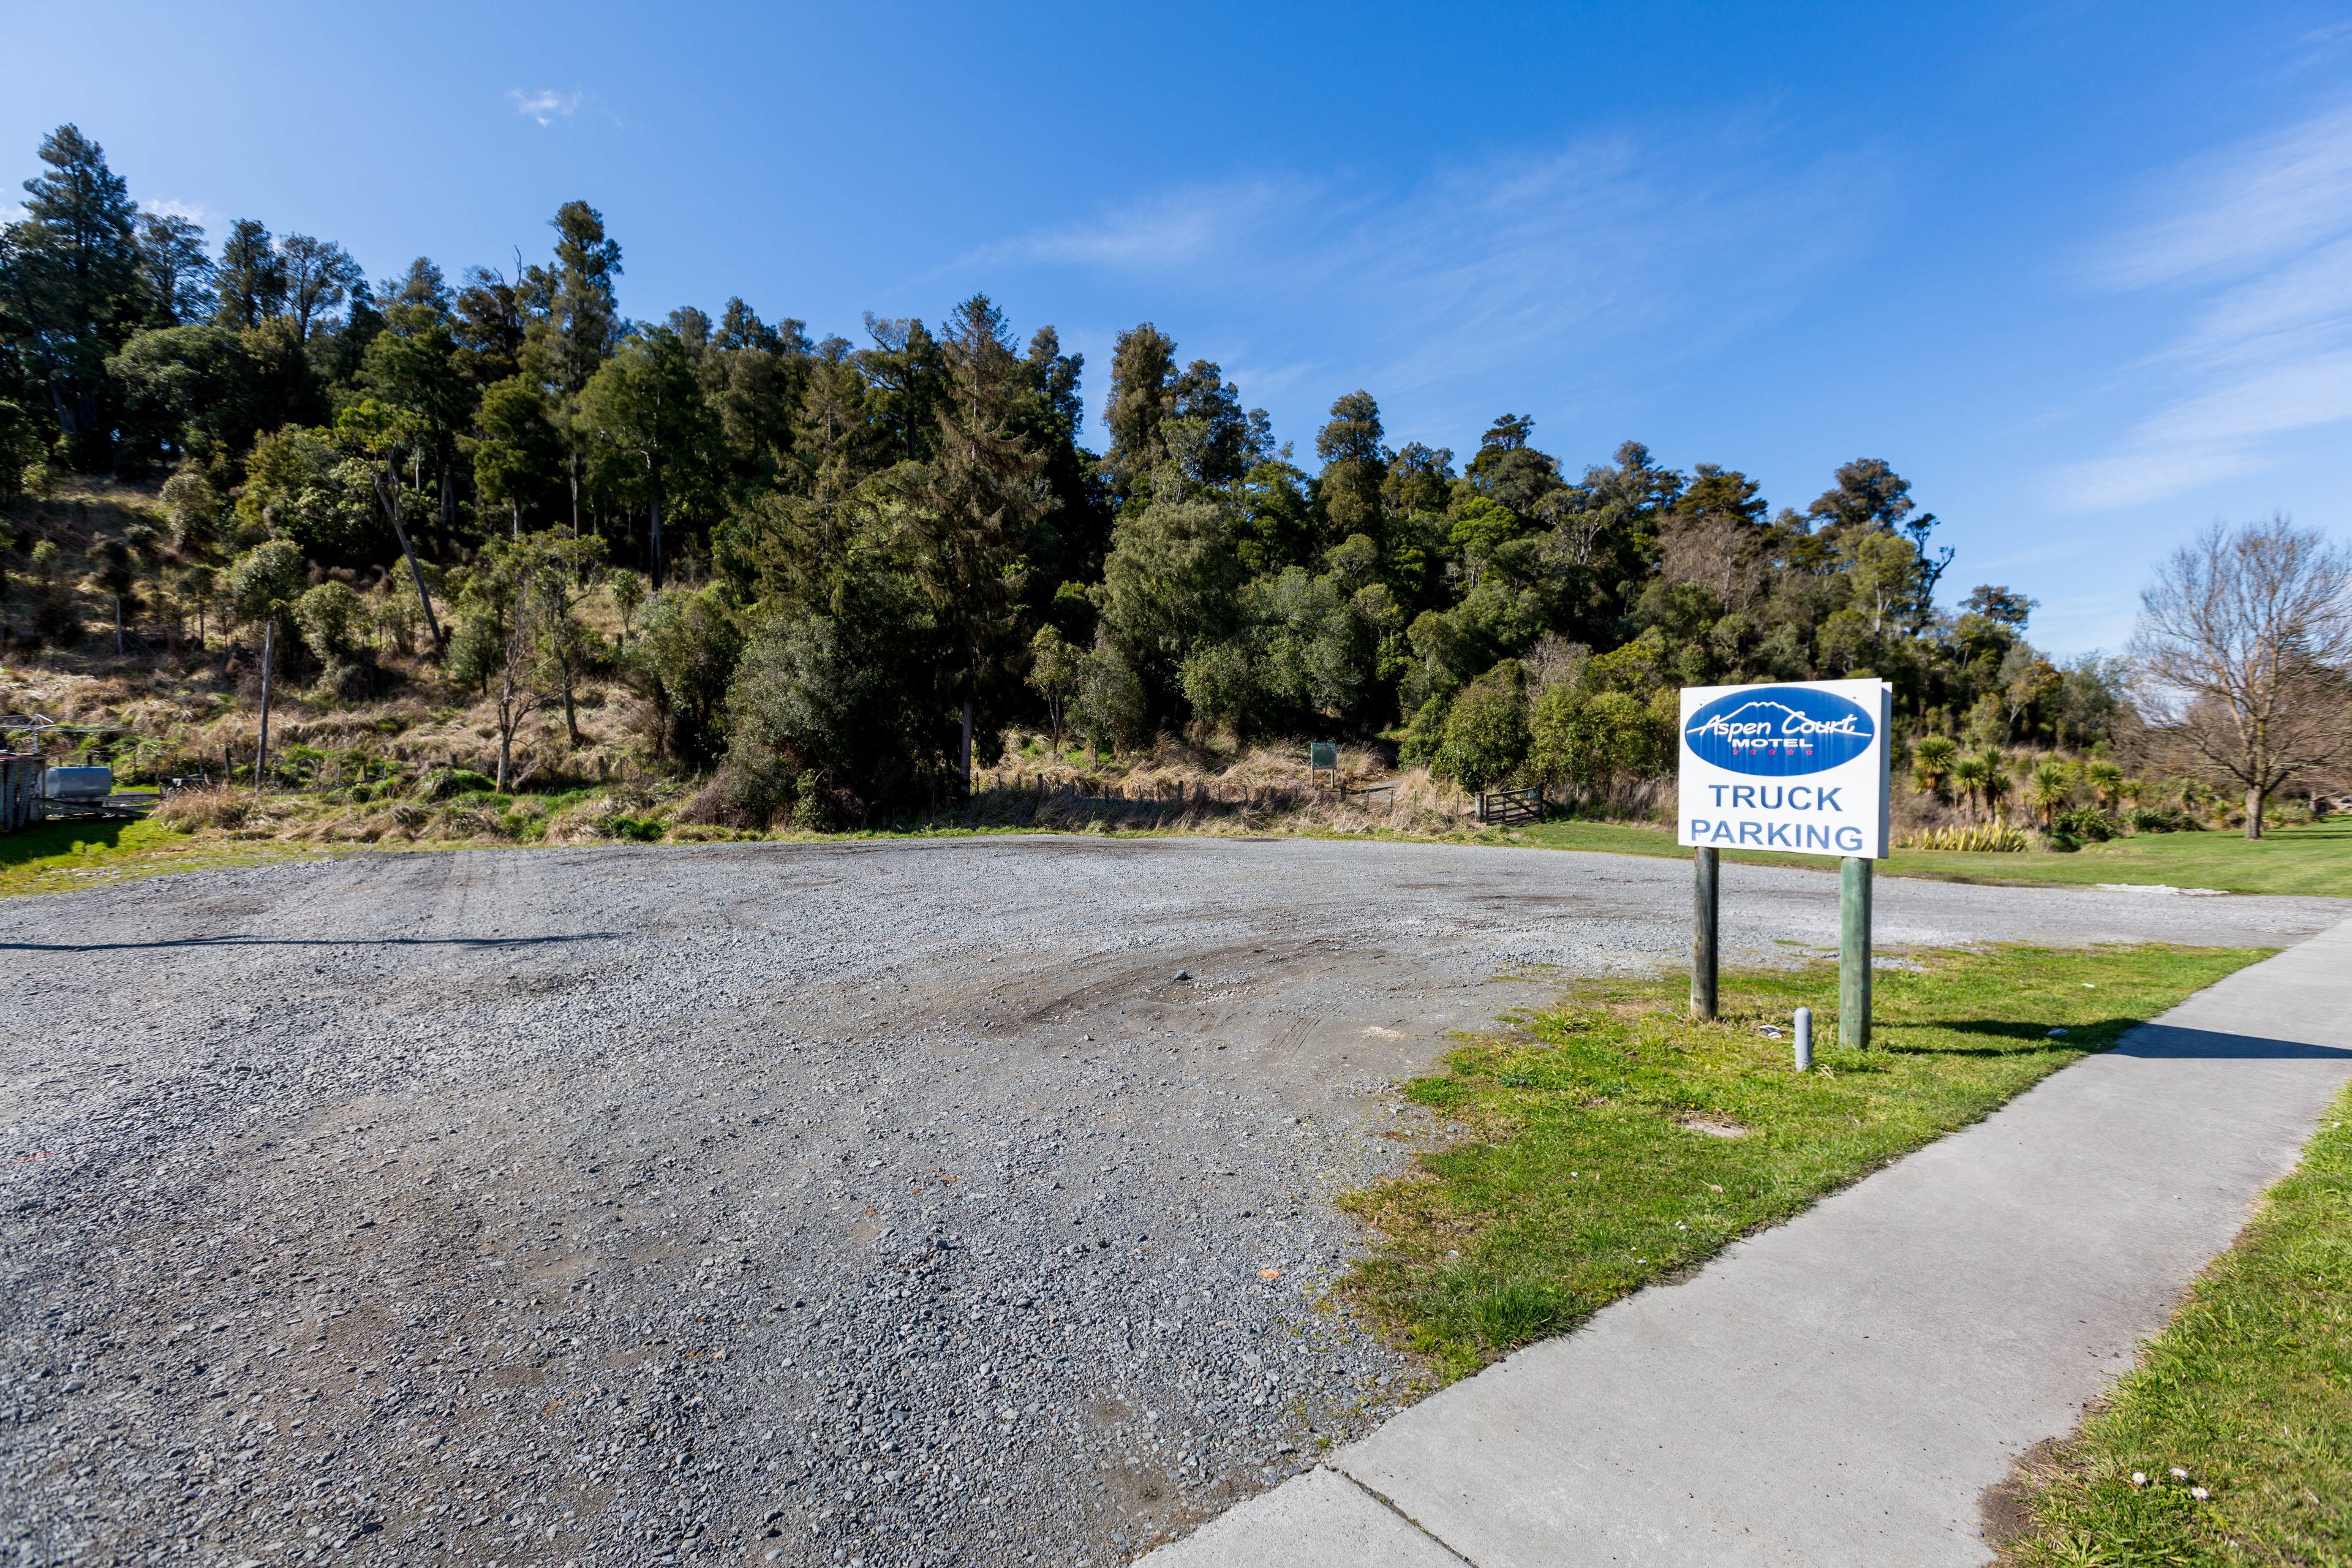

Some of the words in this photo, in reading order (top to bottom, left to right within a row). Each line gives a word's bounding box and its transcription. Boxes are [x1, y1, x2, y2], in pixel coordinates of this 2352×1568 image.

[1688, 714, 1771, 742] Aspen
[1781, 711, 1858, 734] Court
[1732, 738, 1814, 748] MOTEL
[1708, 785, 1843, 812] TRUCK
[1691, 819, 1863, 851] PARKING
